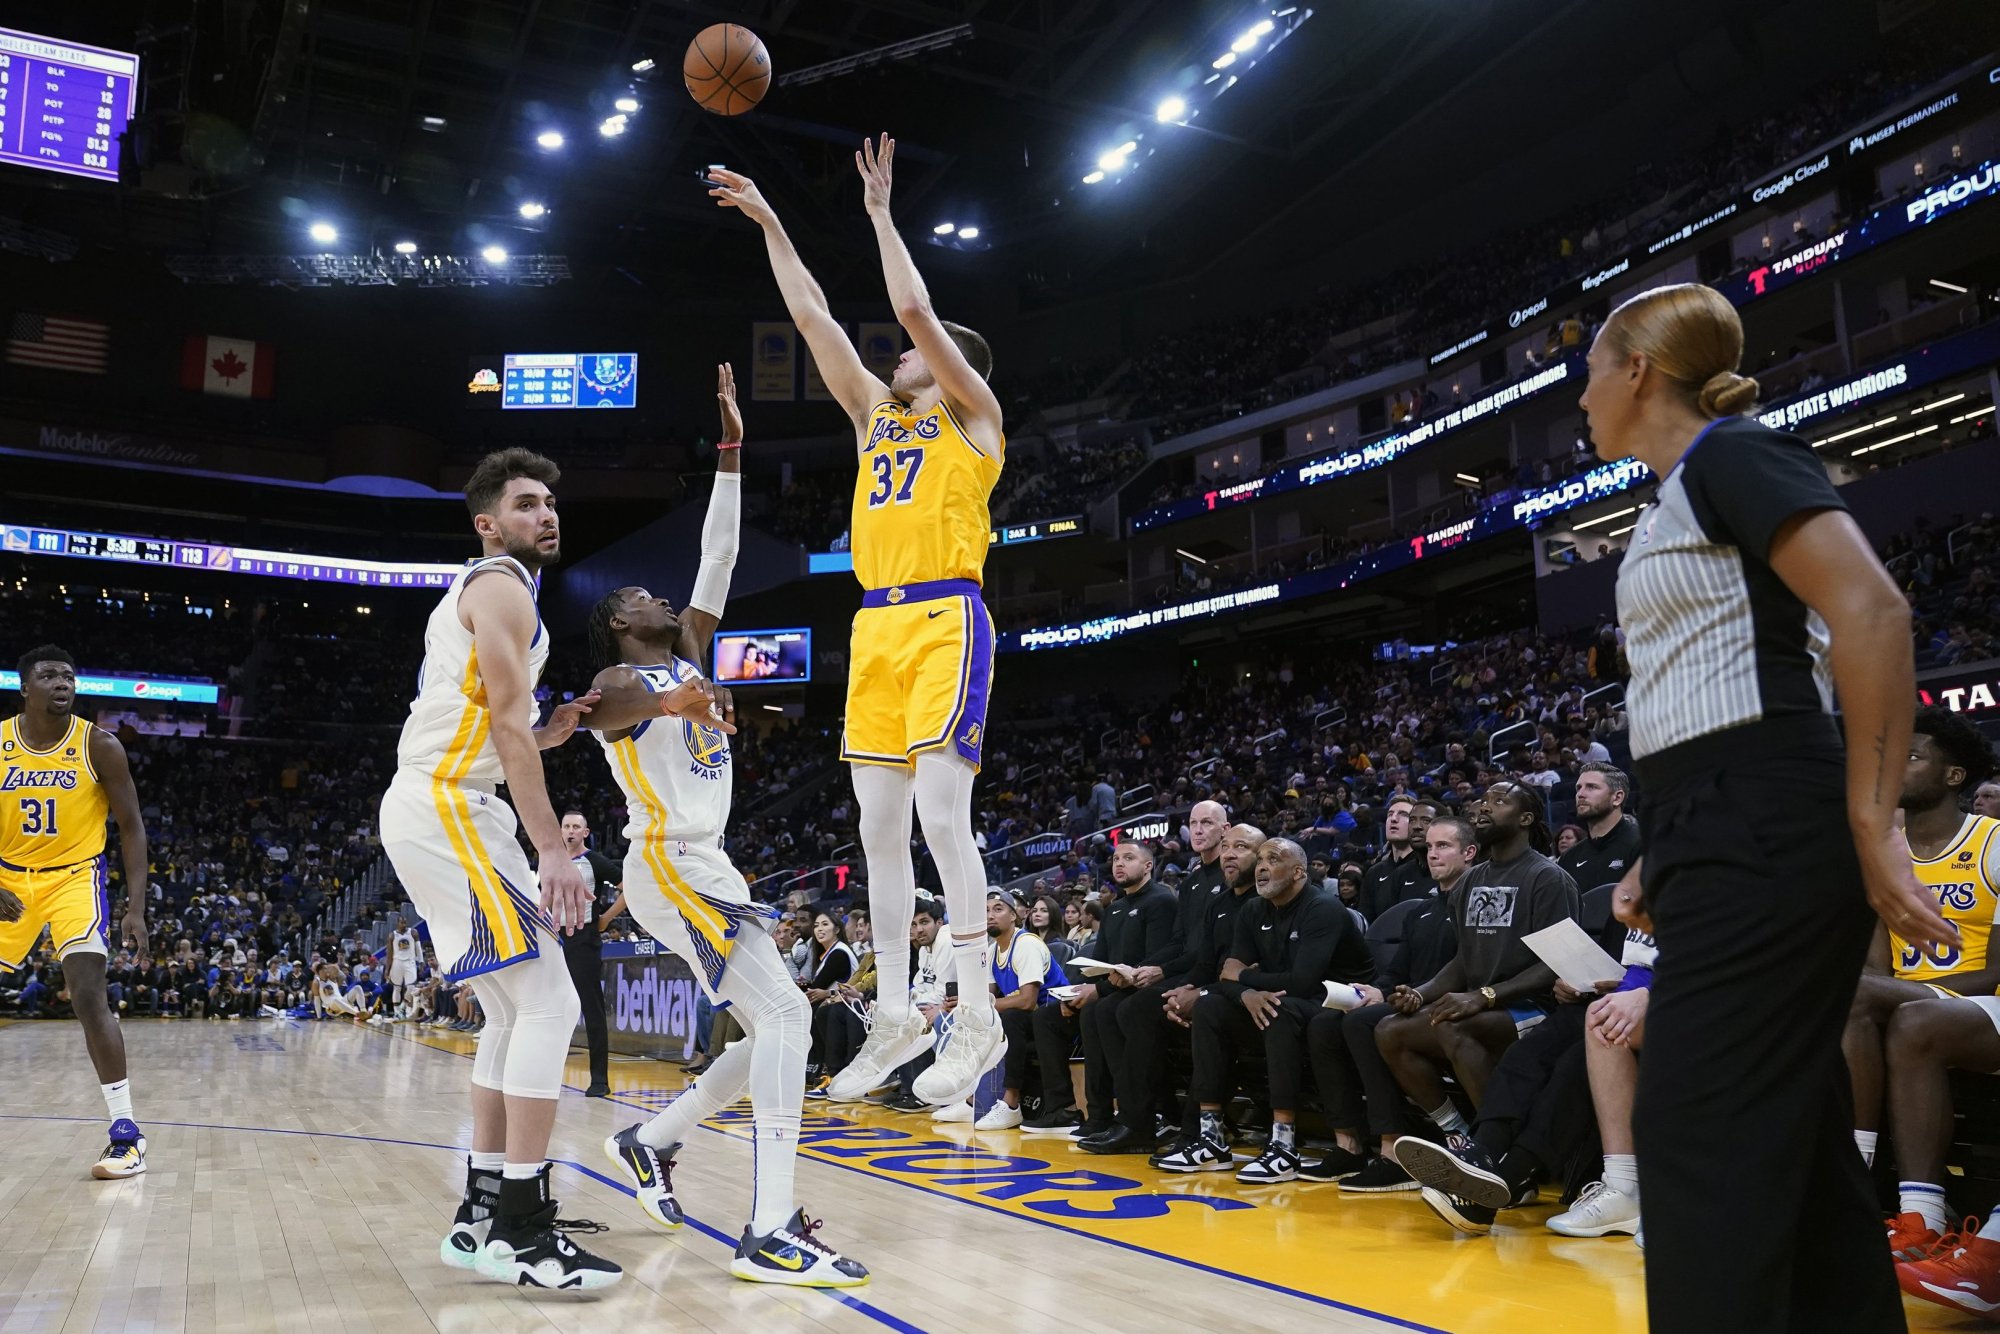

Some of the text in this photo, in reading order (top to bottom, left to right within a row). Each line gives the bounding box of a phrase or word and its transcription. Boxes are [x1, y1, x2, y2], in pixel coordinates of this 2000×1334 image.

[46, 82, 113, 105] TO 12
[1866, 92, 1959, 147] KAISER PERMANENTE
[1753, 155, 1830, 203] Google Cloud
[1649, 204, 1737, 254] UNITED AIRLINES
[1772, 232, 1846, 274] TANDUAY
[1796, 255, 1827, 274] RUM
[1582, 259, 1629, 291] RingCentral
[1522, 298, 1548, 322] pepsi
[1457, 330, 1487, 352] PARTNERS
[1786, 392, 1829, 423] STATE
[1829, 364, 1907, 408] WARRIORS
[1300, 363, 1567, 481] PROUD PARTNER OF THE GOLDEN STATE WARRIORS
[39, 426, 108, 454] Modelo
[868, 447, 924, 511] 37
[1220, 478, 1265, 498] TANDUAY
[1514, 483, 1584, 520] PROUD
[1049, 520, 1077, 533] FINAL
[1426, 518, 1474, 544] TANDUAY
[38, 533, 59, 551] 111
[107, 538, 137, 554] 5:30
[1442, 535, 1462, 547] RUM
[181, 547, 203, 564] 113
[1021, 585, 1279, 646] PROUD PARTNER OF THE GOLDEN STATE WARRIORS
[81, 682, 114, 692] pepsi
[150, 686, 182, 697] pepsi
[5, 741, 13, 751] 6
[0, 766, 77, 791] LAKERS
[20, 798, 58, 837] 31
[635, 943, 650, 955] CHASE
[616, 963, 702, 1060] betway
